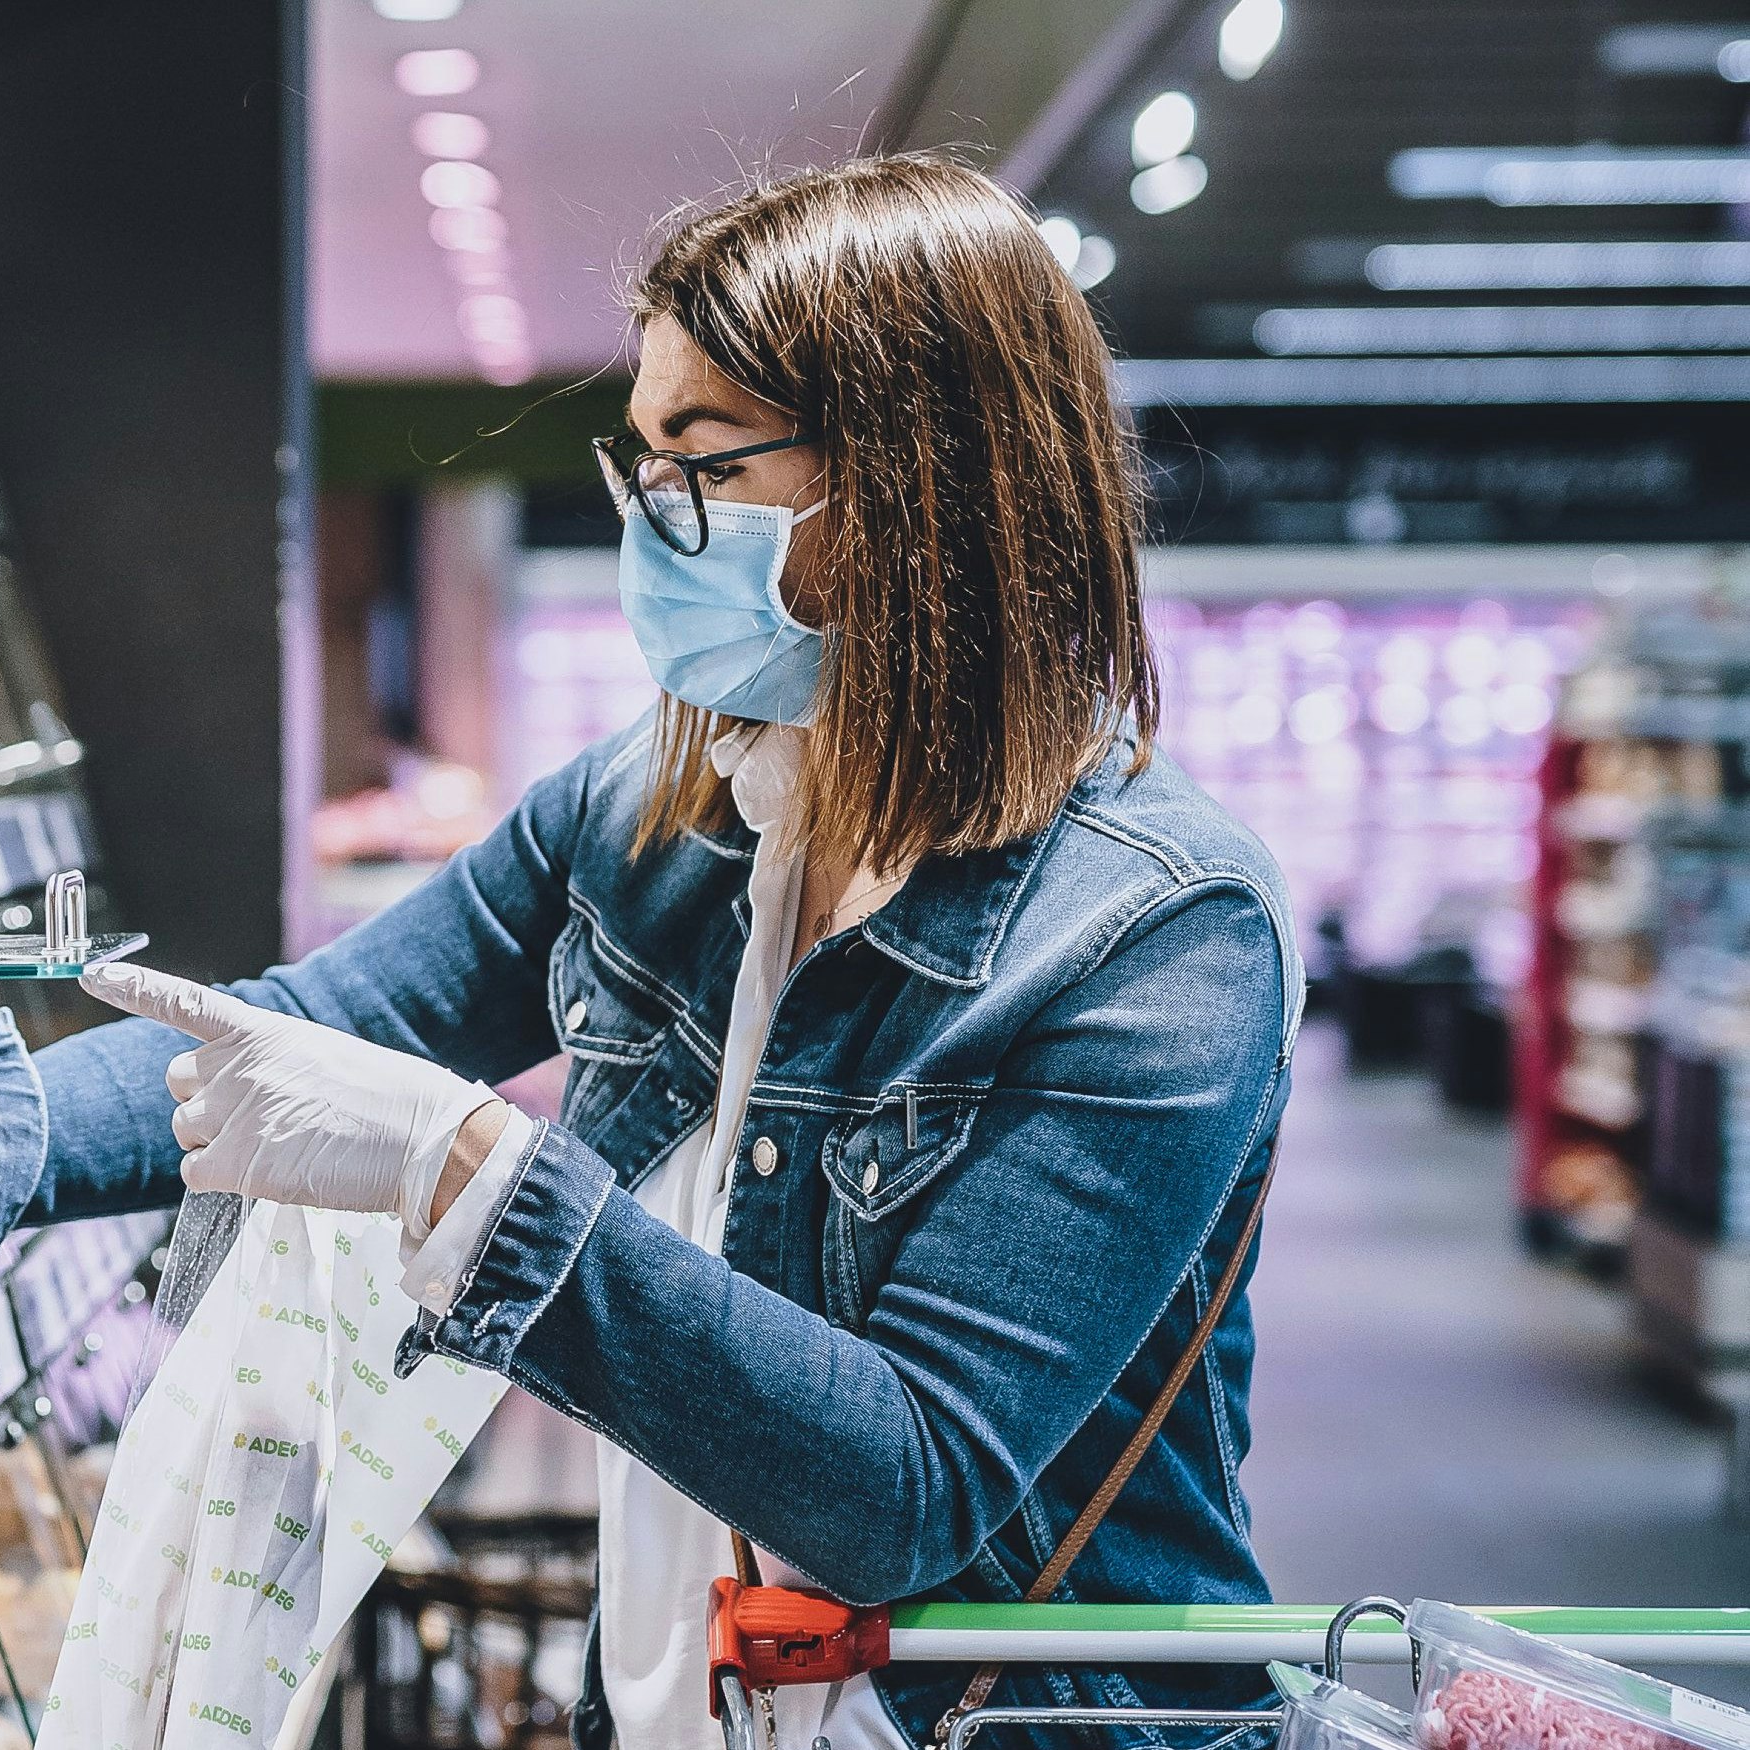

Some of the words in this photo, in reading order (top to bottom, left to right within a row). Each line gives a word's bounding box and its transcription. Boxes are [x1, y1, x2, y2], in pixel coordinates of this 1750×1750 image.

[275, 1307, 327, 1333] ADEG
[352, 1359, 389, 1396] ADEG
[316, 1388, 331, 1408] AD
[248, 1436, 299, 1458] ADEG
[348, 1443, 395, 1480] ADEG
[208, 1500, 236, 1516] DEG
[362, 1533, 393, 1561] ADE
[182, 1634, 211, 1651] ADEG
[278, 1667, 297, 1689] AD
